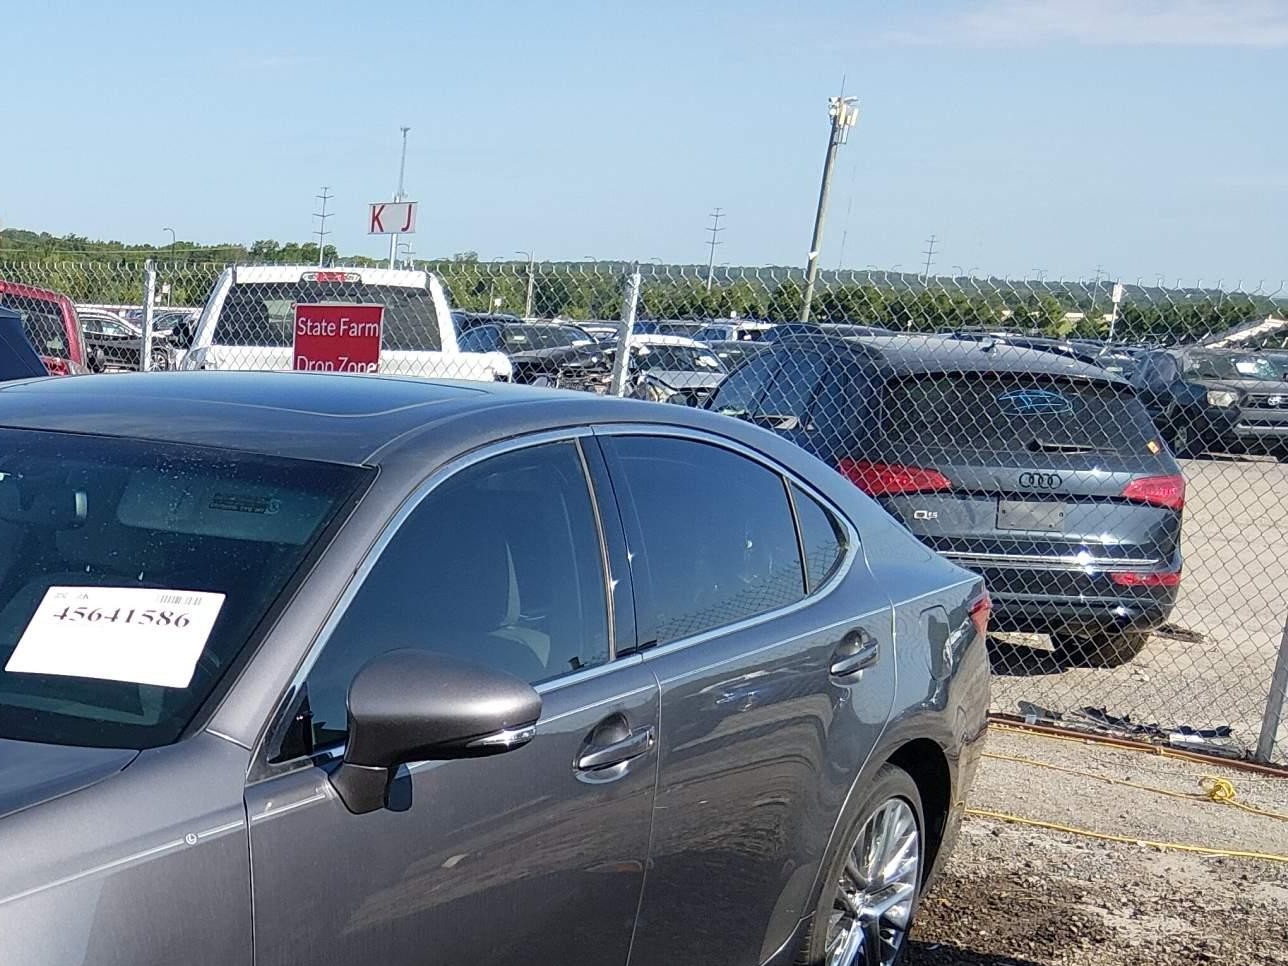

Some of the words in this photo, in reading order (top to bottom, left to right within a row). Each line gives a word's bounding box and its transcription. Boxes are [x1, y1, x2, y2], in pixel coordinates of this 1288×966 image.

[371, 204, 385, 233] K
[401, 203, 412, 232] J
[297, 317, 336, 336] State
[339, 318, 379, 337] Farm
[53, 606, 190, 628] 45641586
